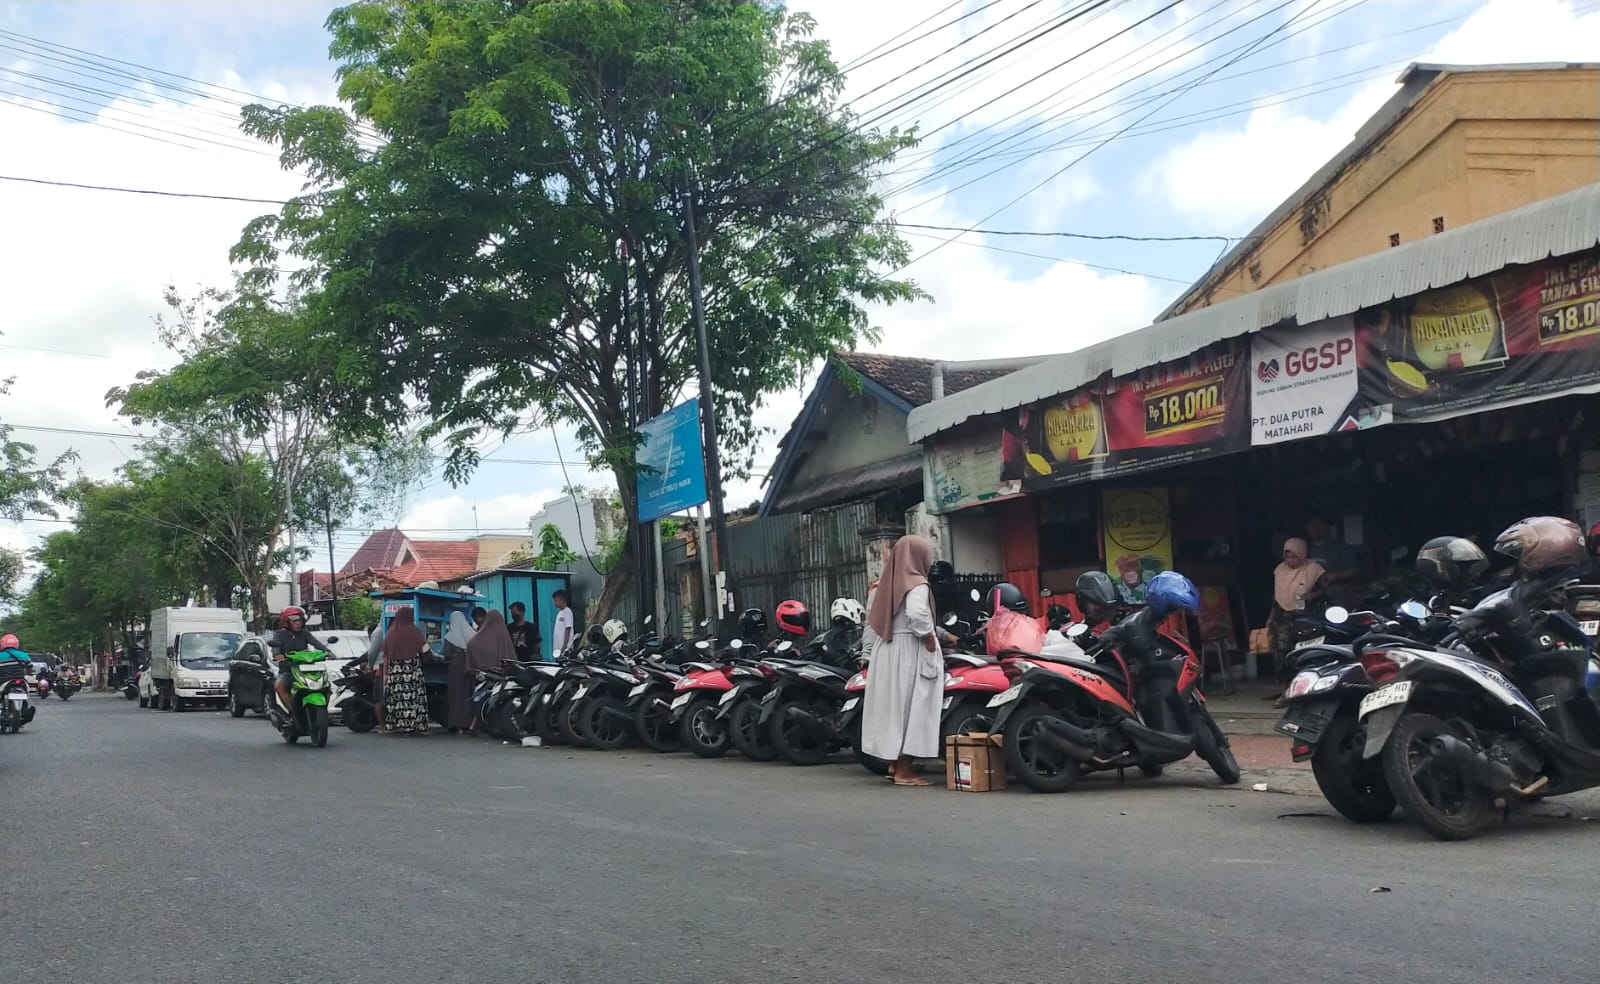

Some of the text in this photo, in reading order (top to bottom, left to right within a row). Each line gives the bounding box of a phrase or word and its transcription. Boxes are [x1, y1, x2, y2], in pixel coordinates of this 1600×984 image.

[1540, 273, 1600, 303] TANPA FIL
[1542, 316, 1554, 330] Rp
[1285, 338, 1353, 377] GGSP
[1148, 405, 1160, 422] Rp
[1252, 405, 1325, 427] PT. DUA PUTRA
[1264, 422, 1314, 439] MATAHARI
